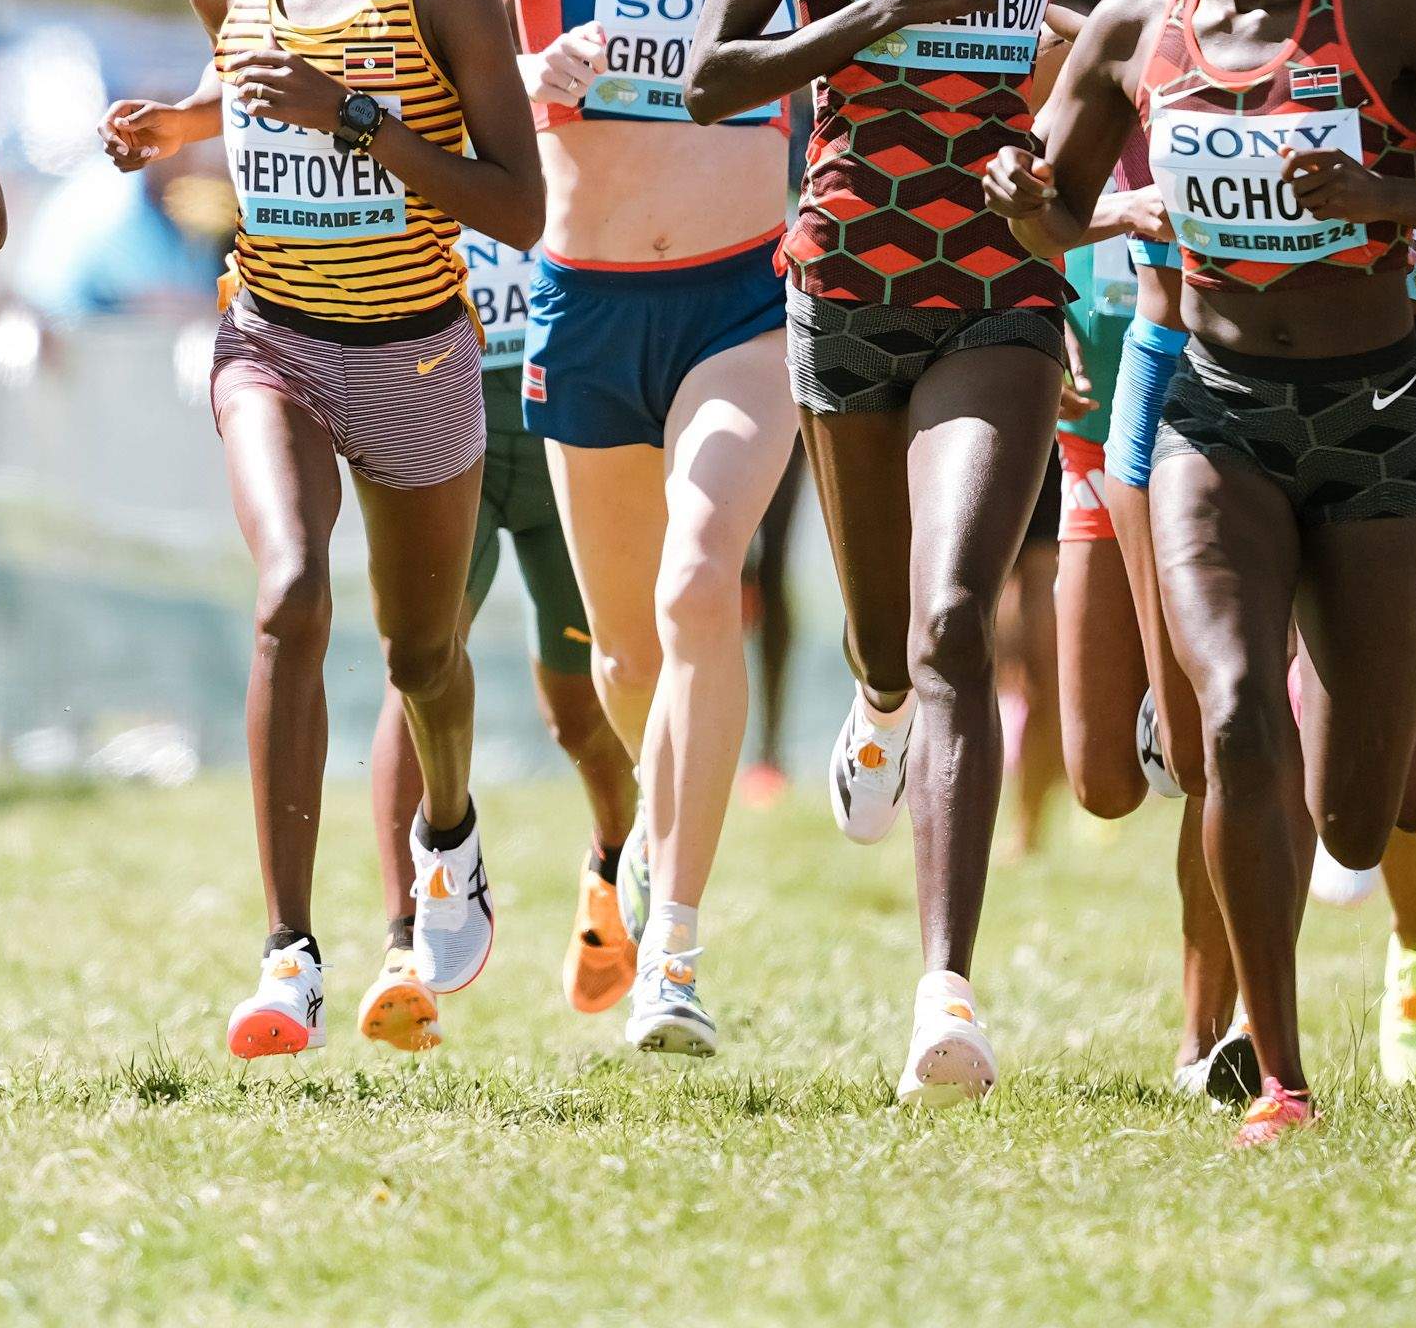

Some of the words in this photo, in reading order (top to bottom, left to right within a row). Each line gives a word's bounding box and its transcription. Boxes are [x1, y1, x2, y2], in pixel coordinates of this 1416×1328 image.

[606, 35, 695, 80] GRØ
[916, 40, 1015, 62] BELGRADE
[1170, 124, 1337, 159] SONY
[1185, 175, 1304, 222] ACHO
[256, 207, 361, 228] BELGRADE
[365, 207, 396, 225] 24
[1219, 232, 1326, 252] BELGRADE
[1326, 222, 1357, 244] 24
